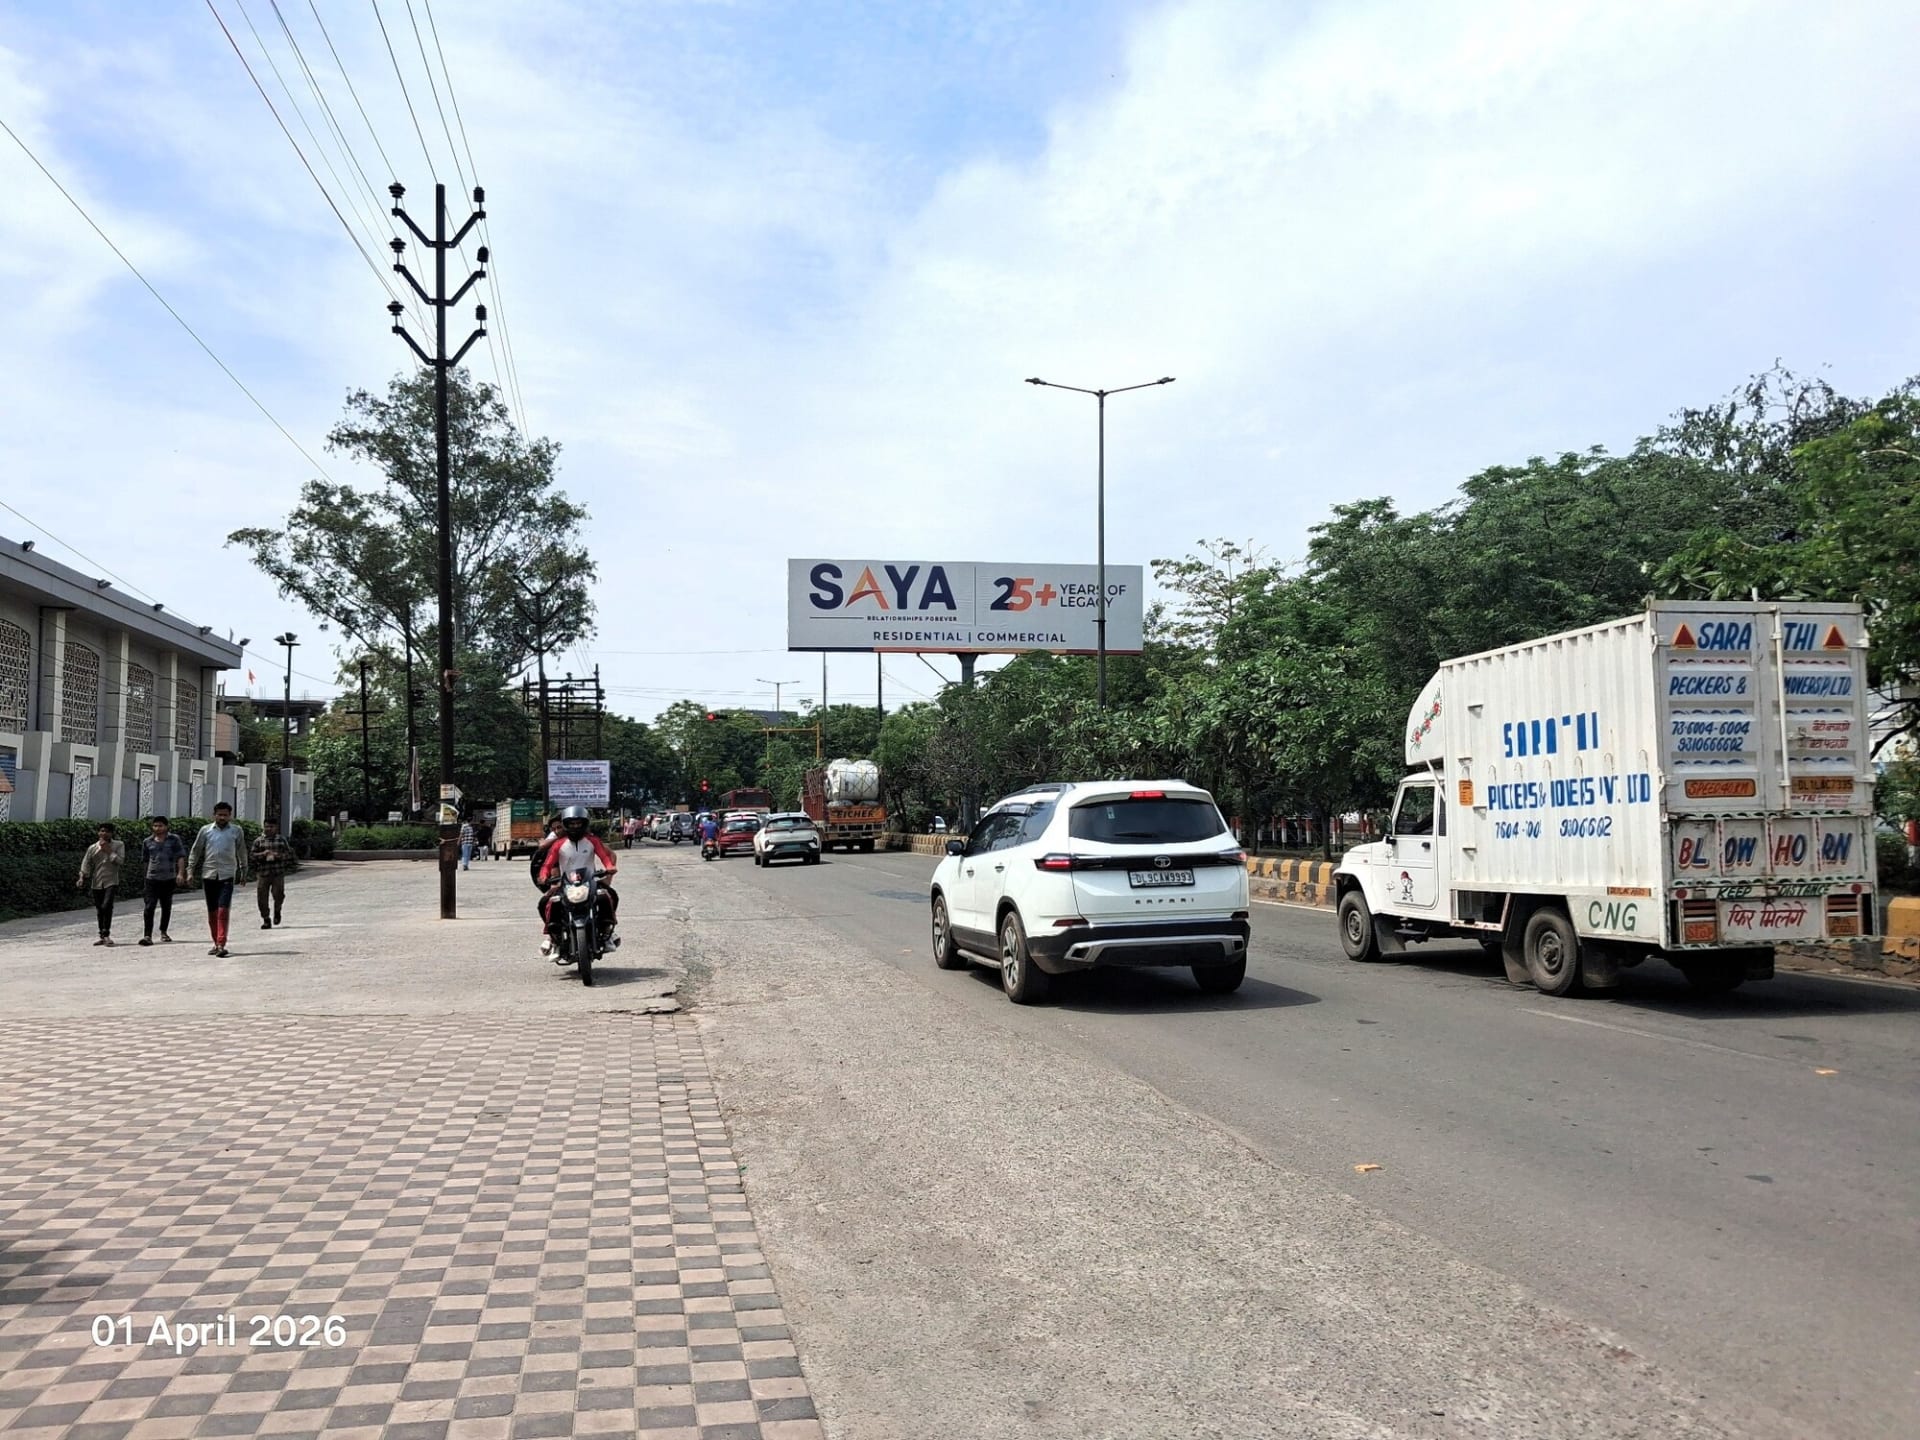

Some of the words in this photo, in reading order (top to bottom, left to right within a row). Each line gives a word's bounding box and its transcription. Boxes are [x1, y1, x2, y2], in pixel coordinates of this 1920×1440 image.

[809, 563, 957, 611] SAYA
[990, 577, 1057, 612] 25+
[1107, 584, 1127, 596] OF
[873, 631, 962, 642] RESIDENTIAL
[977, 633, 1066, 643] COMMERCIAL
[1717, 887, 1753, 899] KEEP
[1588, 900, 1638, 932] CNG
